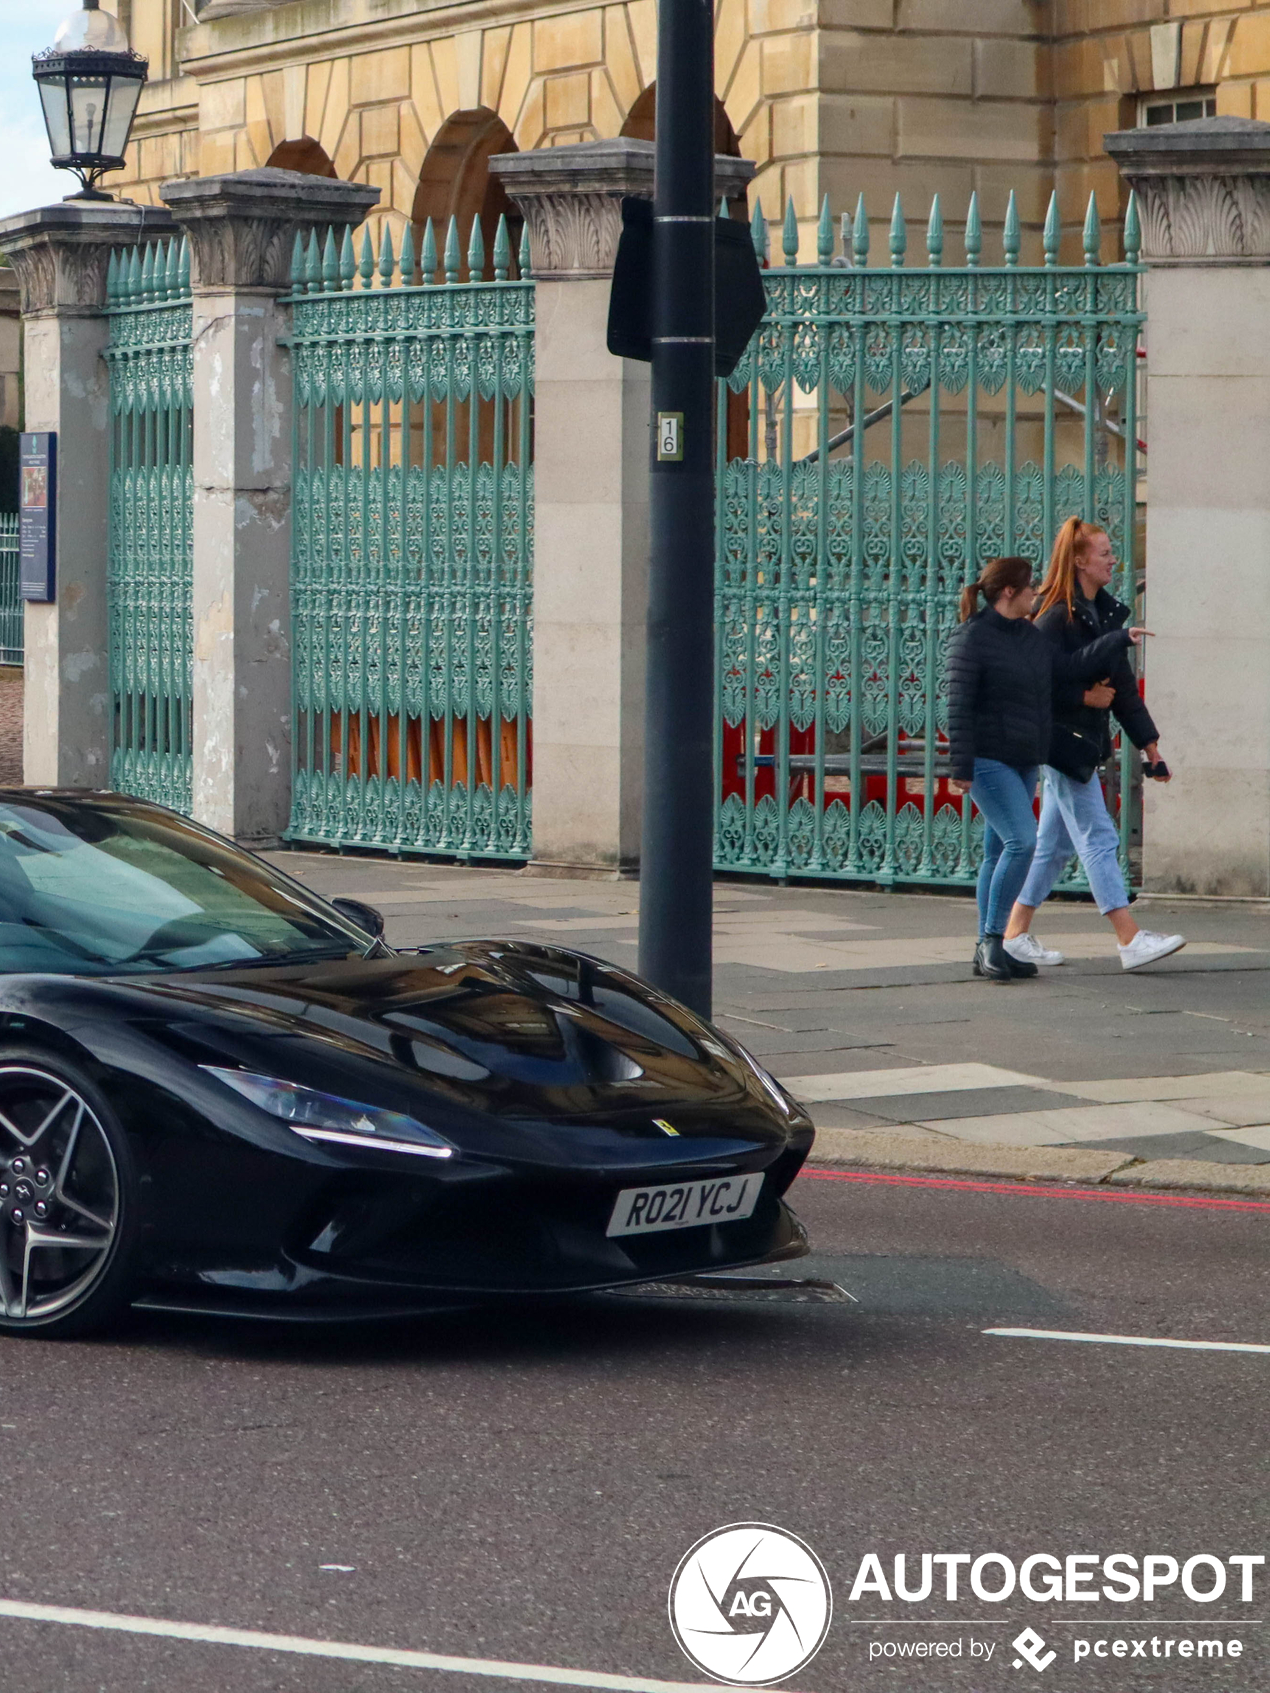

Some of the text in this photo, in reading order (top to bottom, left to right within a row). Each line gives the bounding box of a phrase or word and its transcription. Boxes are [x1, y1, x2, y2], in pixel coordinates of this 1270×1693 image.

[663, 420, 675, 452] 16
[625, 1179, 748, 1227] RO21 YCJ
